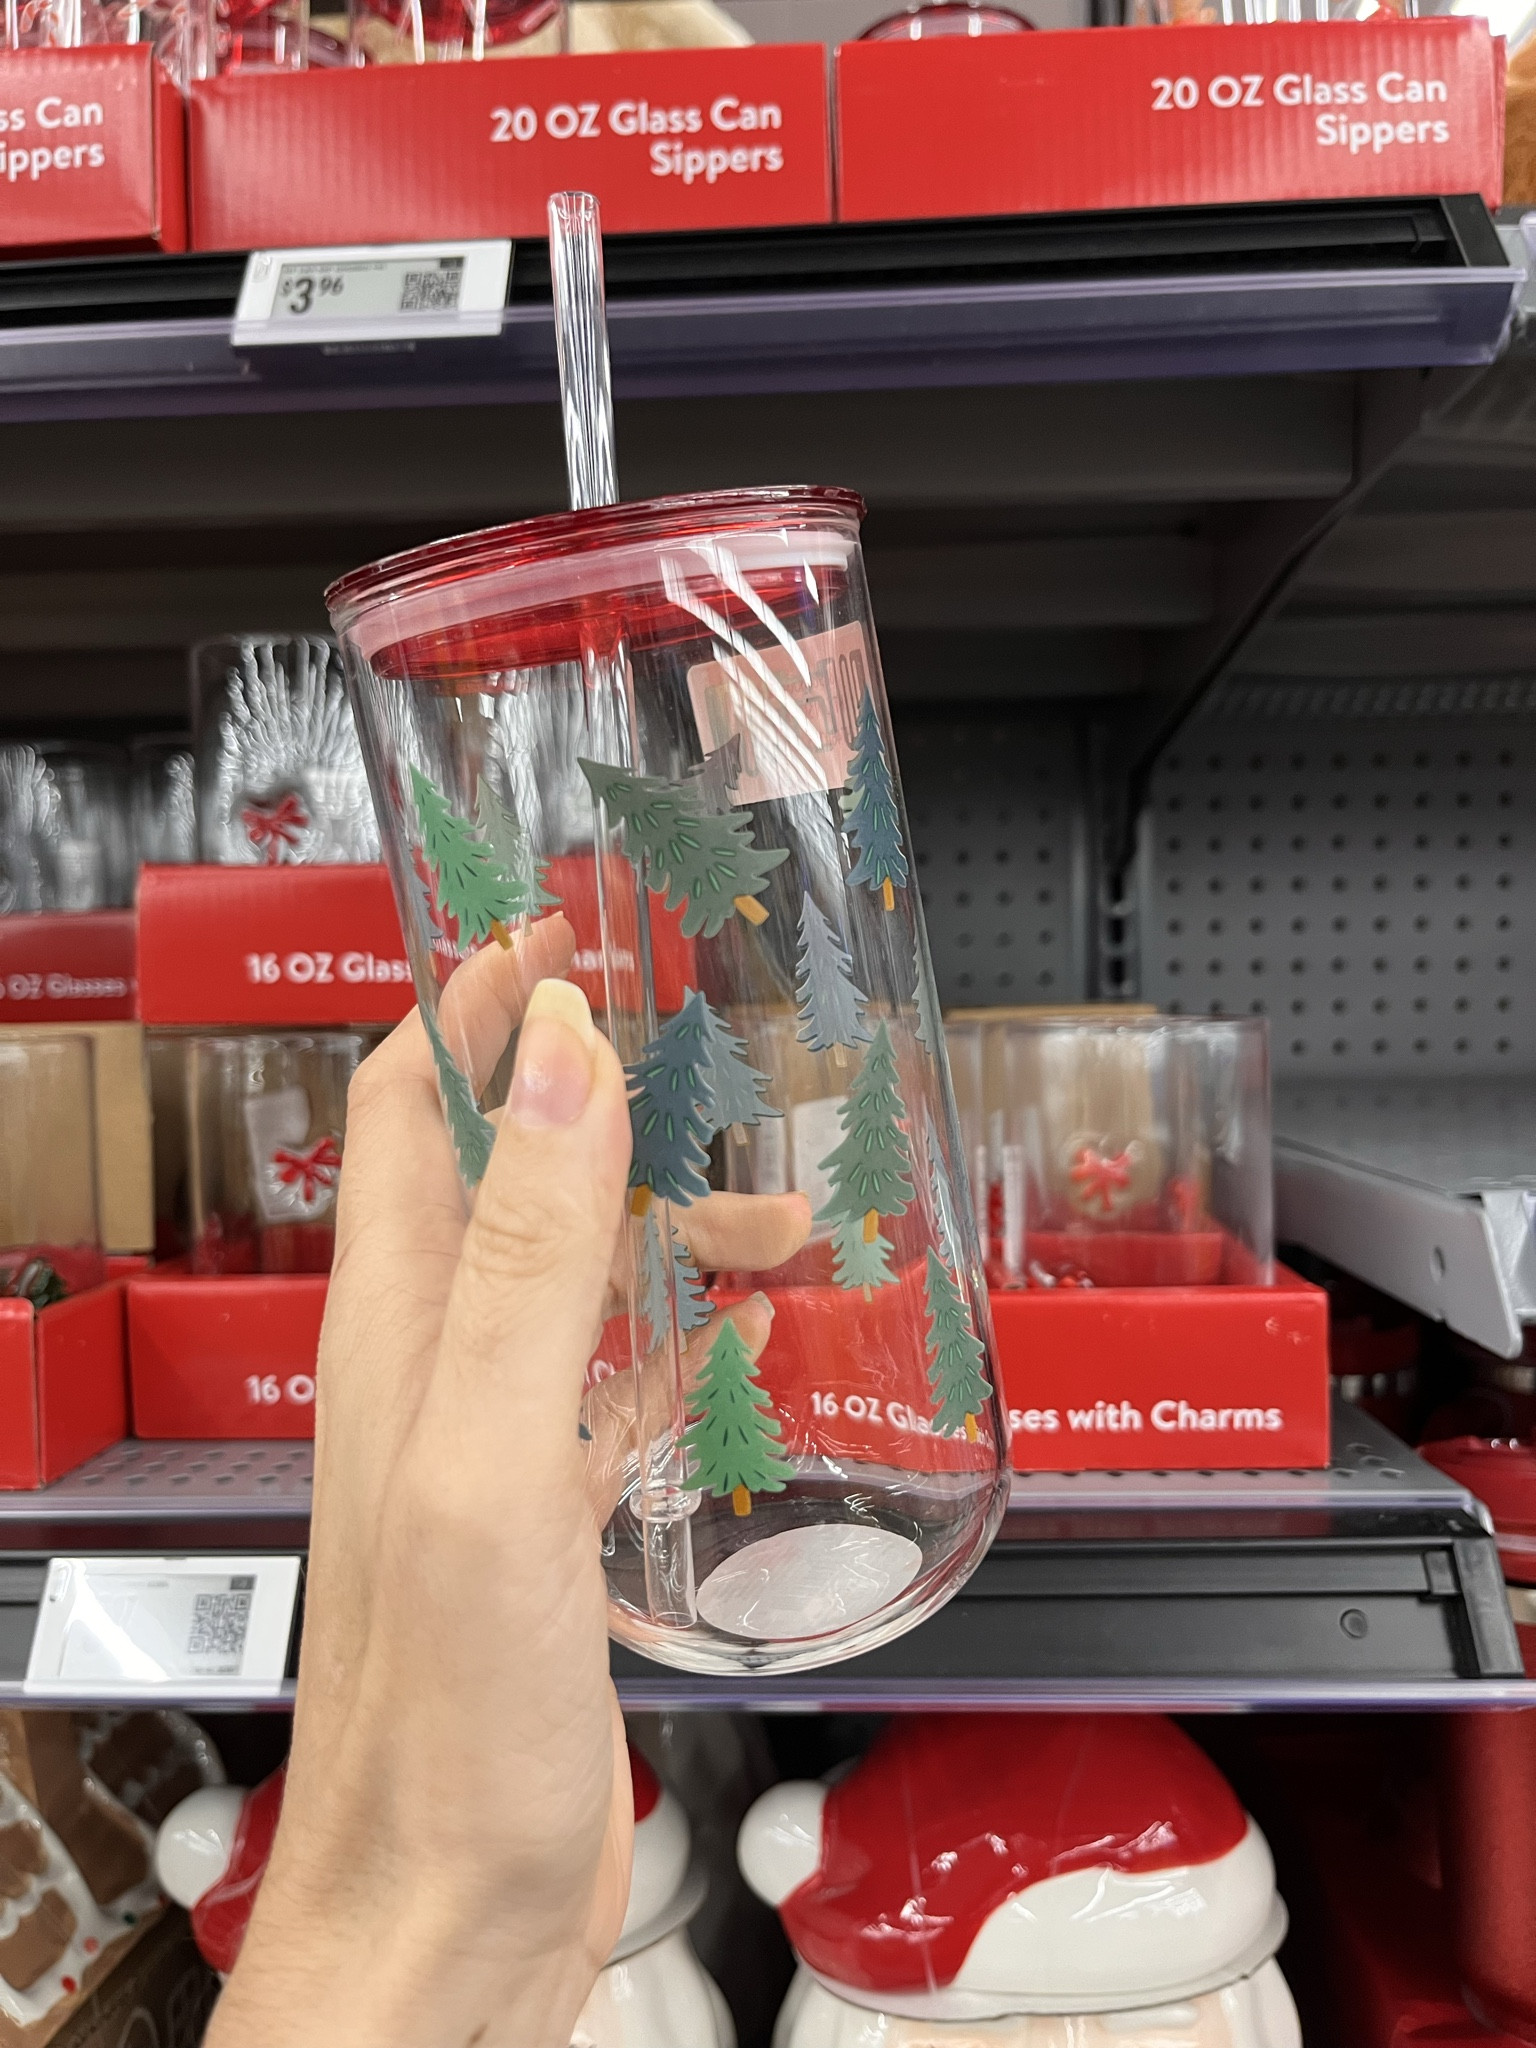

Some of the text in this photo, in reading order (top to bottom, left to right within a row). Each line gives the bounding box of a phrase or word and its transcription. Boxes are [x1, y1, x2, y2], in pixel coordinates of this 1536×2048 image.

[1151, 71, 1448, 111] 20 OZ Glass Can
[34, 96, 103, 129] Can
[489, 97, 783, 143] 20 OZ Glass Can
[1315, 113, 1450, 155] Sippers
[649, 142, 784, 184] Sippers
[246, 952, 281, 984] 16
[287, 951, 336, 984] OZ
[245, 1374, 281, 1405] 16
[811, 1391, 840, 1417] 16
[843, 1394, 883, 1425] OZ
[1067, 1400, 1142, 1432] with
[1150, 1399, 1283, 1432] Charms
